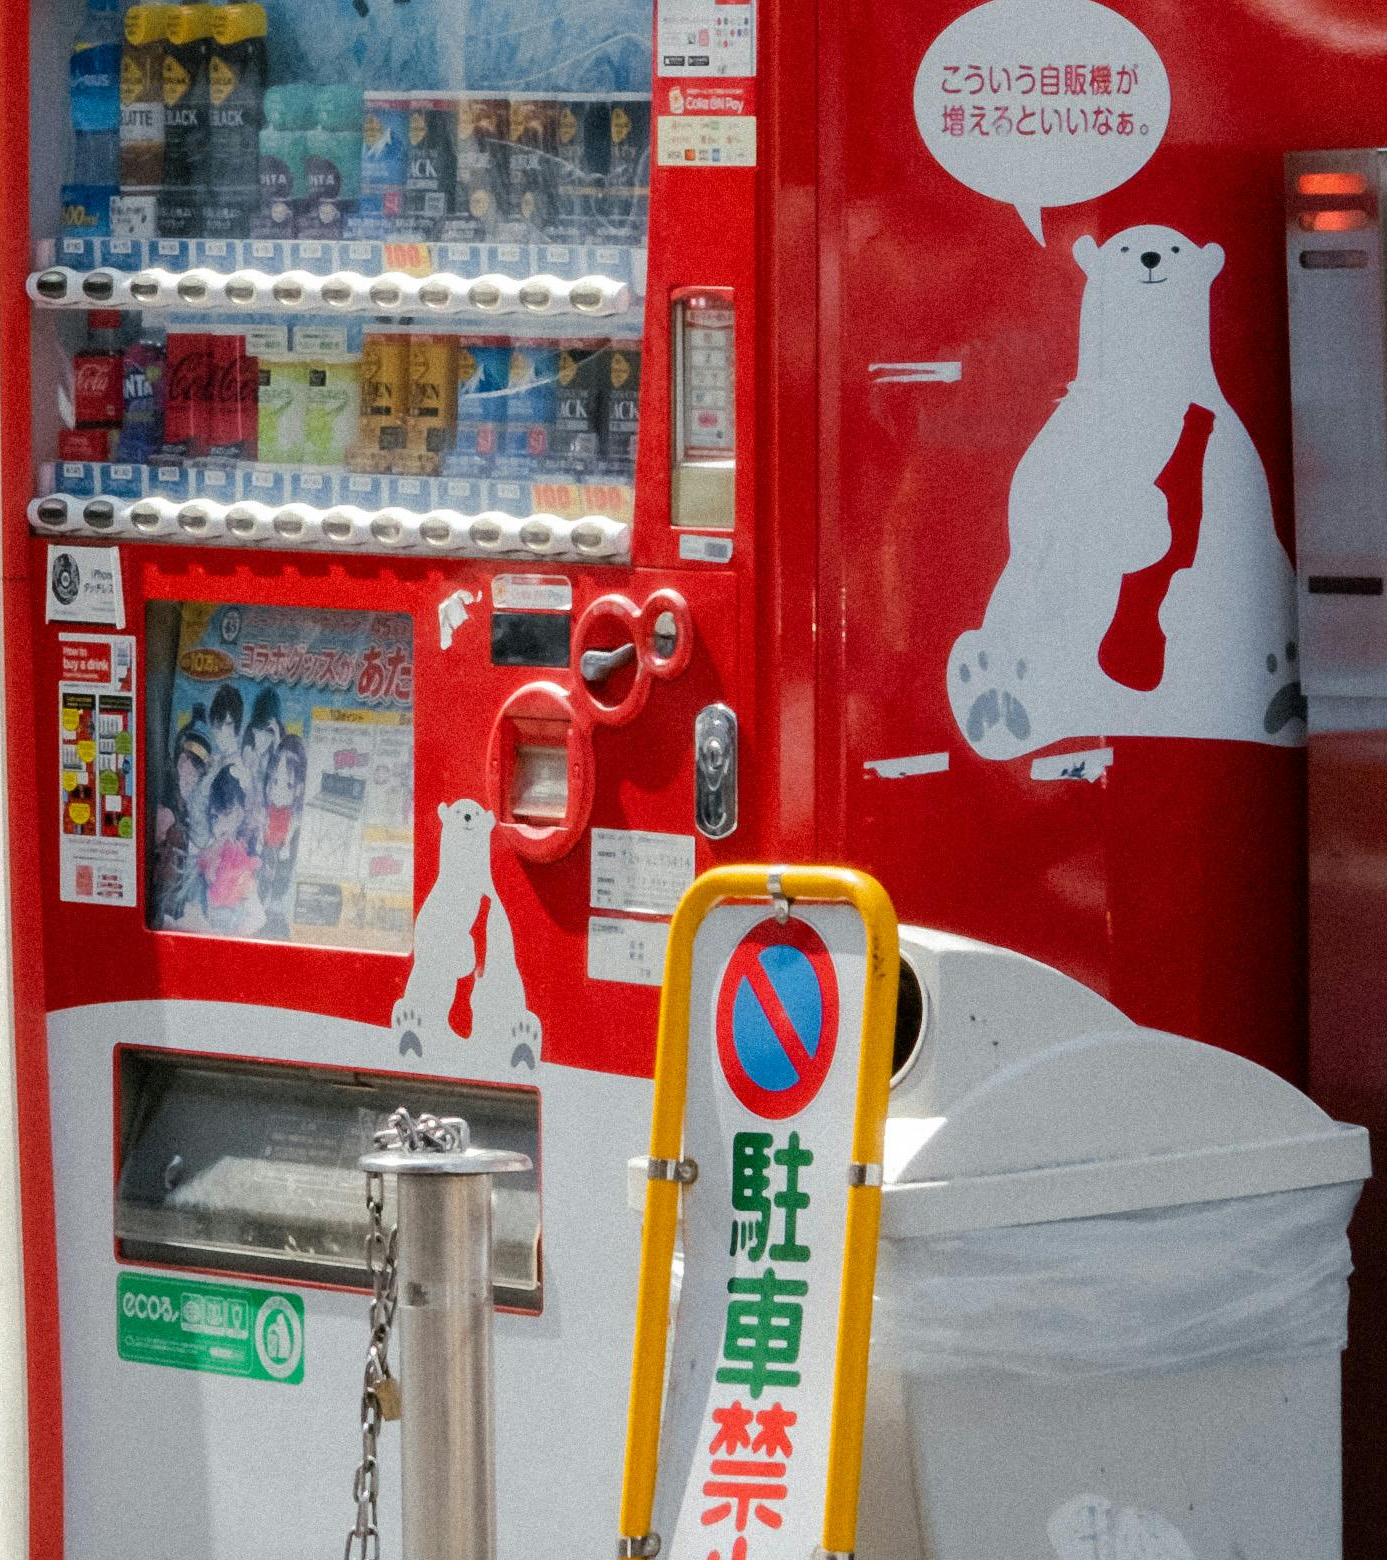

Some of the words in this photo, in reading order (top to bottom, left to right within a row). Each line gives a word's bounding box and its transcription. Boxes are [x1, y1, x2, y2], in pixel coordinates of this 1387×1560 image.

[941, 64, 1138, 97] こういう自販機が
[941, 105, 1150, 138] 増えるといいなぁ。
[62, 659, 78, 672] buy
[86, 658, 109, 670] drink
